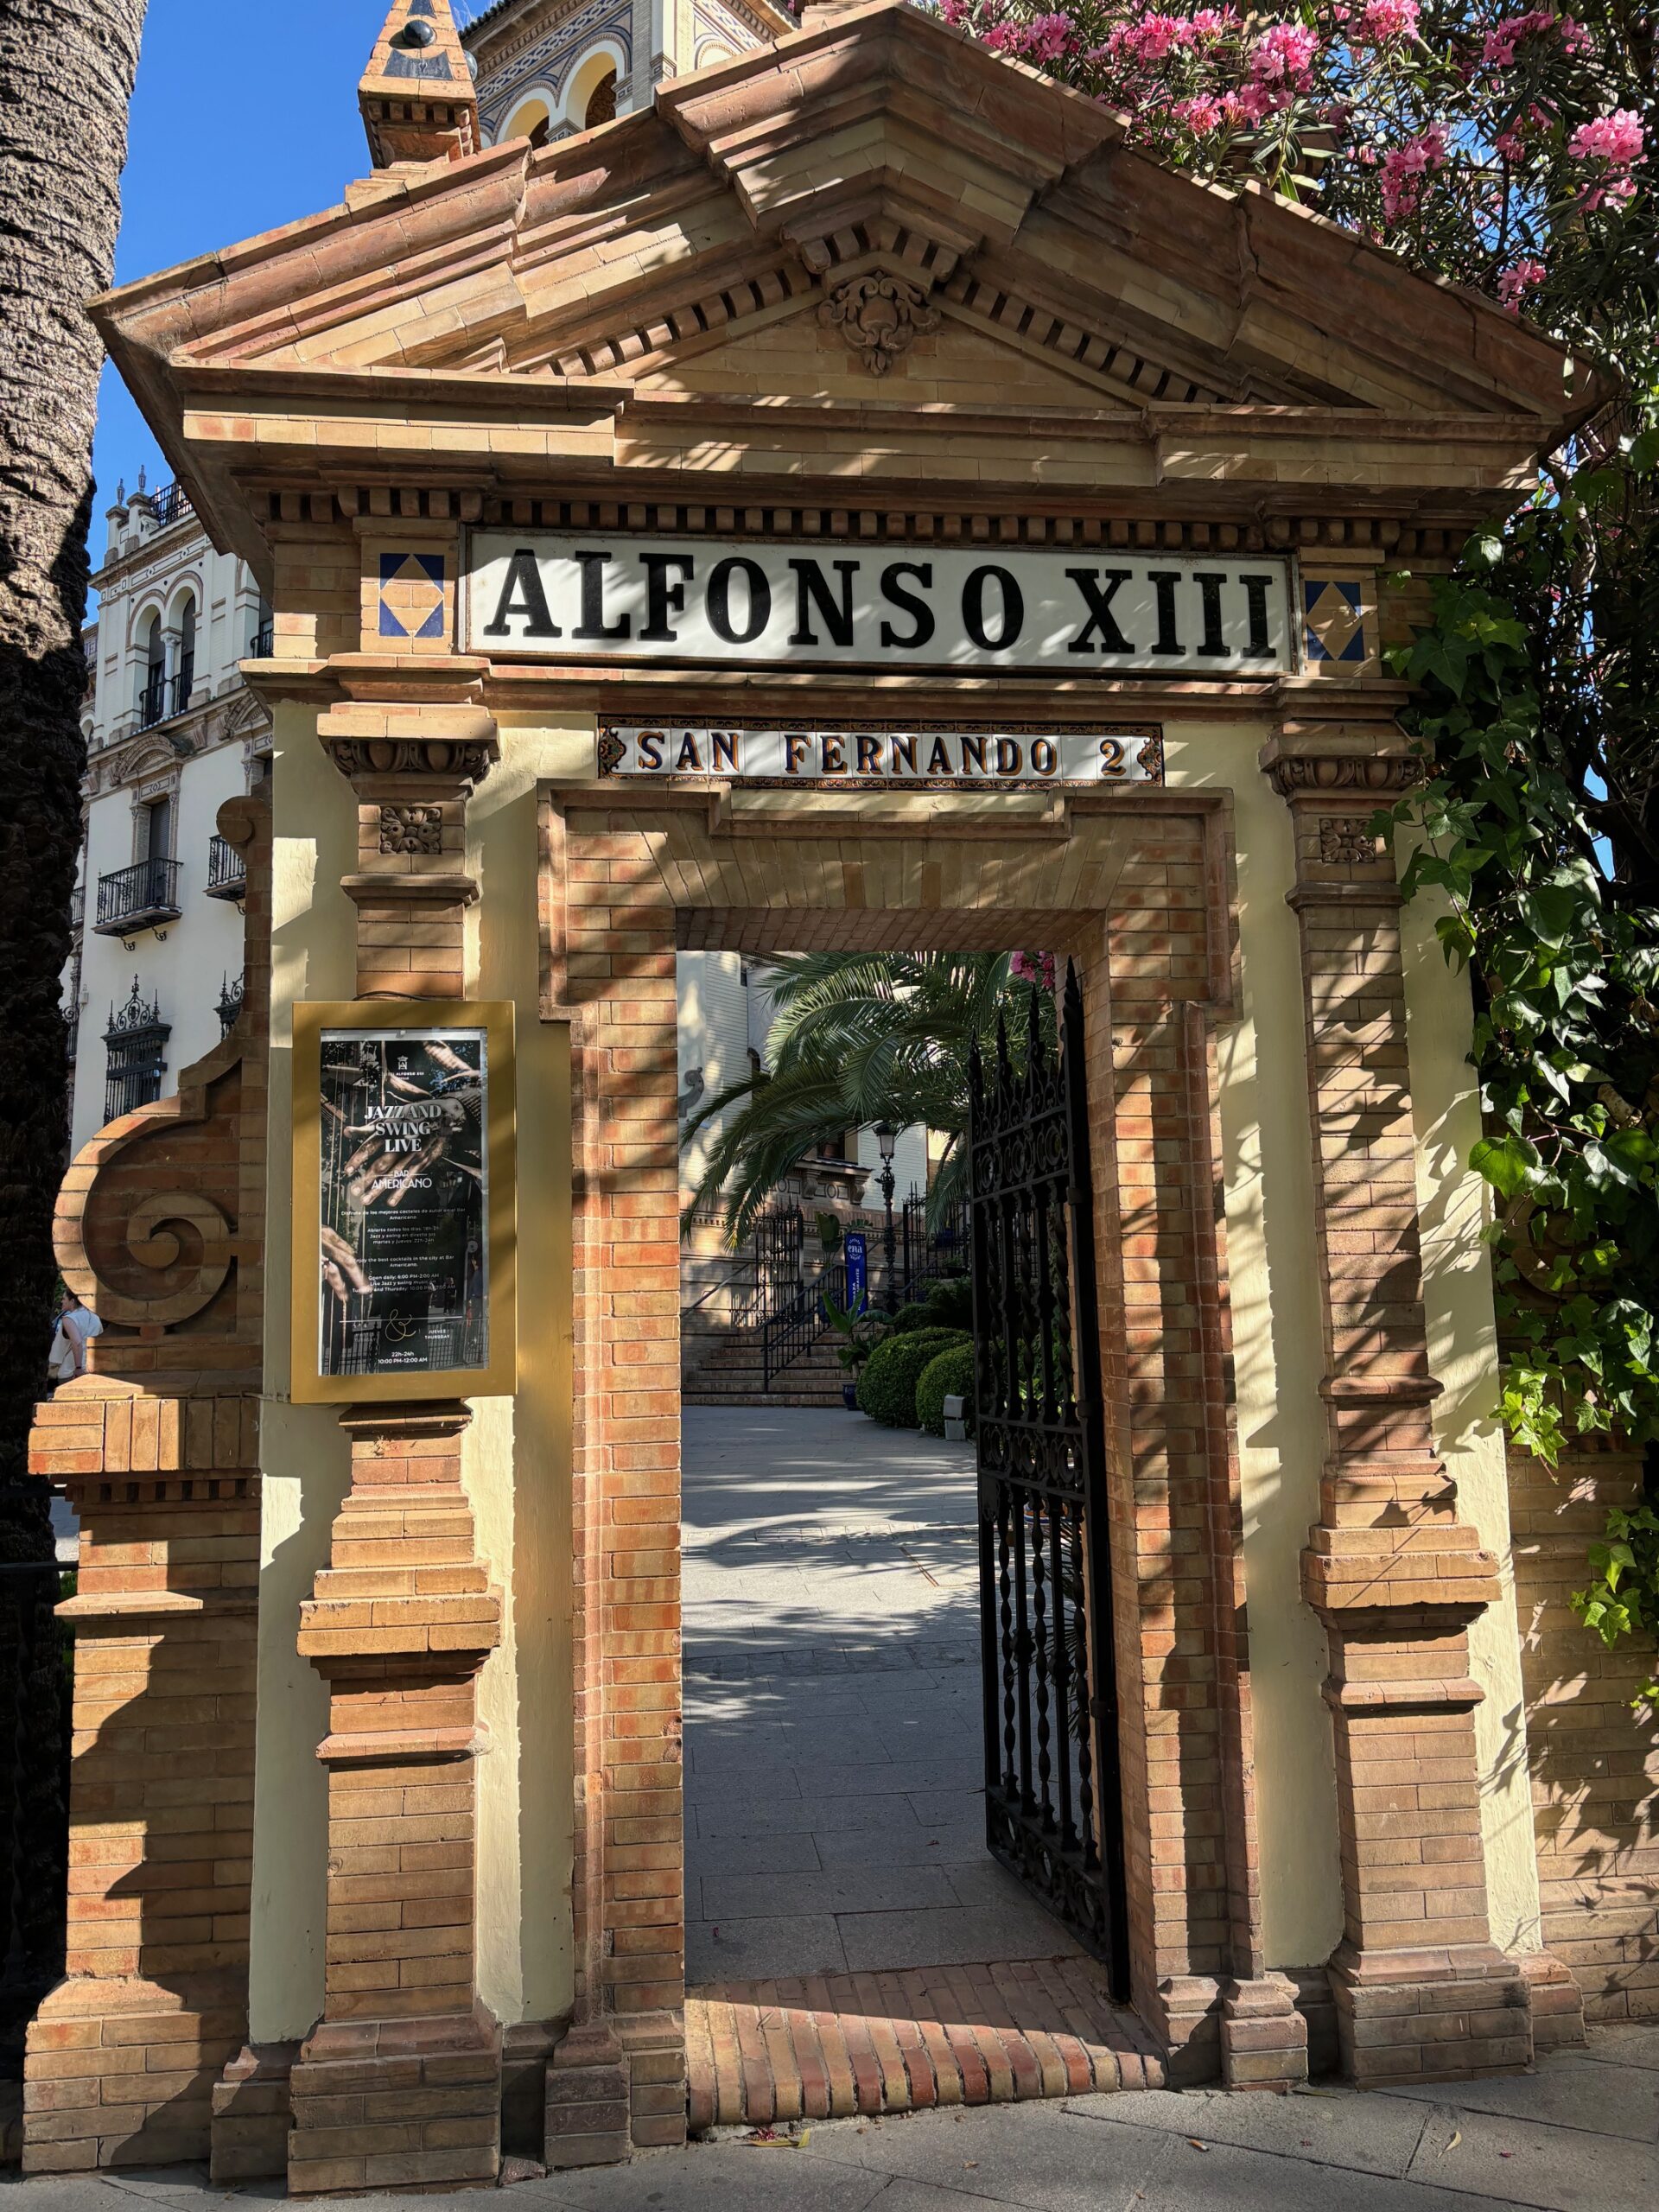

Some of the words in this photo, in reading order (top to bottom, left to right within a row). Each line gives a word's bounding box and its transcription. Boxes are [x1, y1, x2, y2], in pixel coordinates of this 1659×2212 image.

[483, 549, 1024, 651] ALFONSO
[1065, 569, 1276, 658] XIII
[637, 731, 741, 773] SAN
[784, 734, 1058, 777] FERNANDO
[1099, 739, 1127, 777] 2
[364, 1105, 404, 1120] JAZZ
[408, 1104, 442, 1119] AND
[375, 1122, 431, 1136] SWING
[385, 1138, 422, 1153] LIVE
[372, 1178, 432, 1190] AMERICANO
